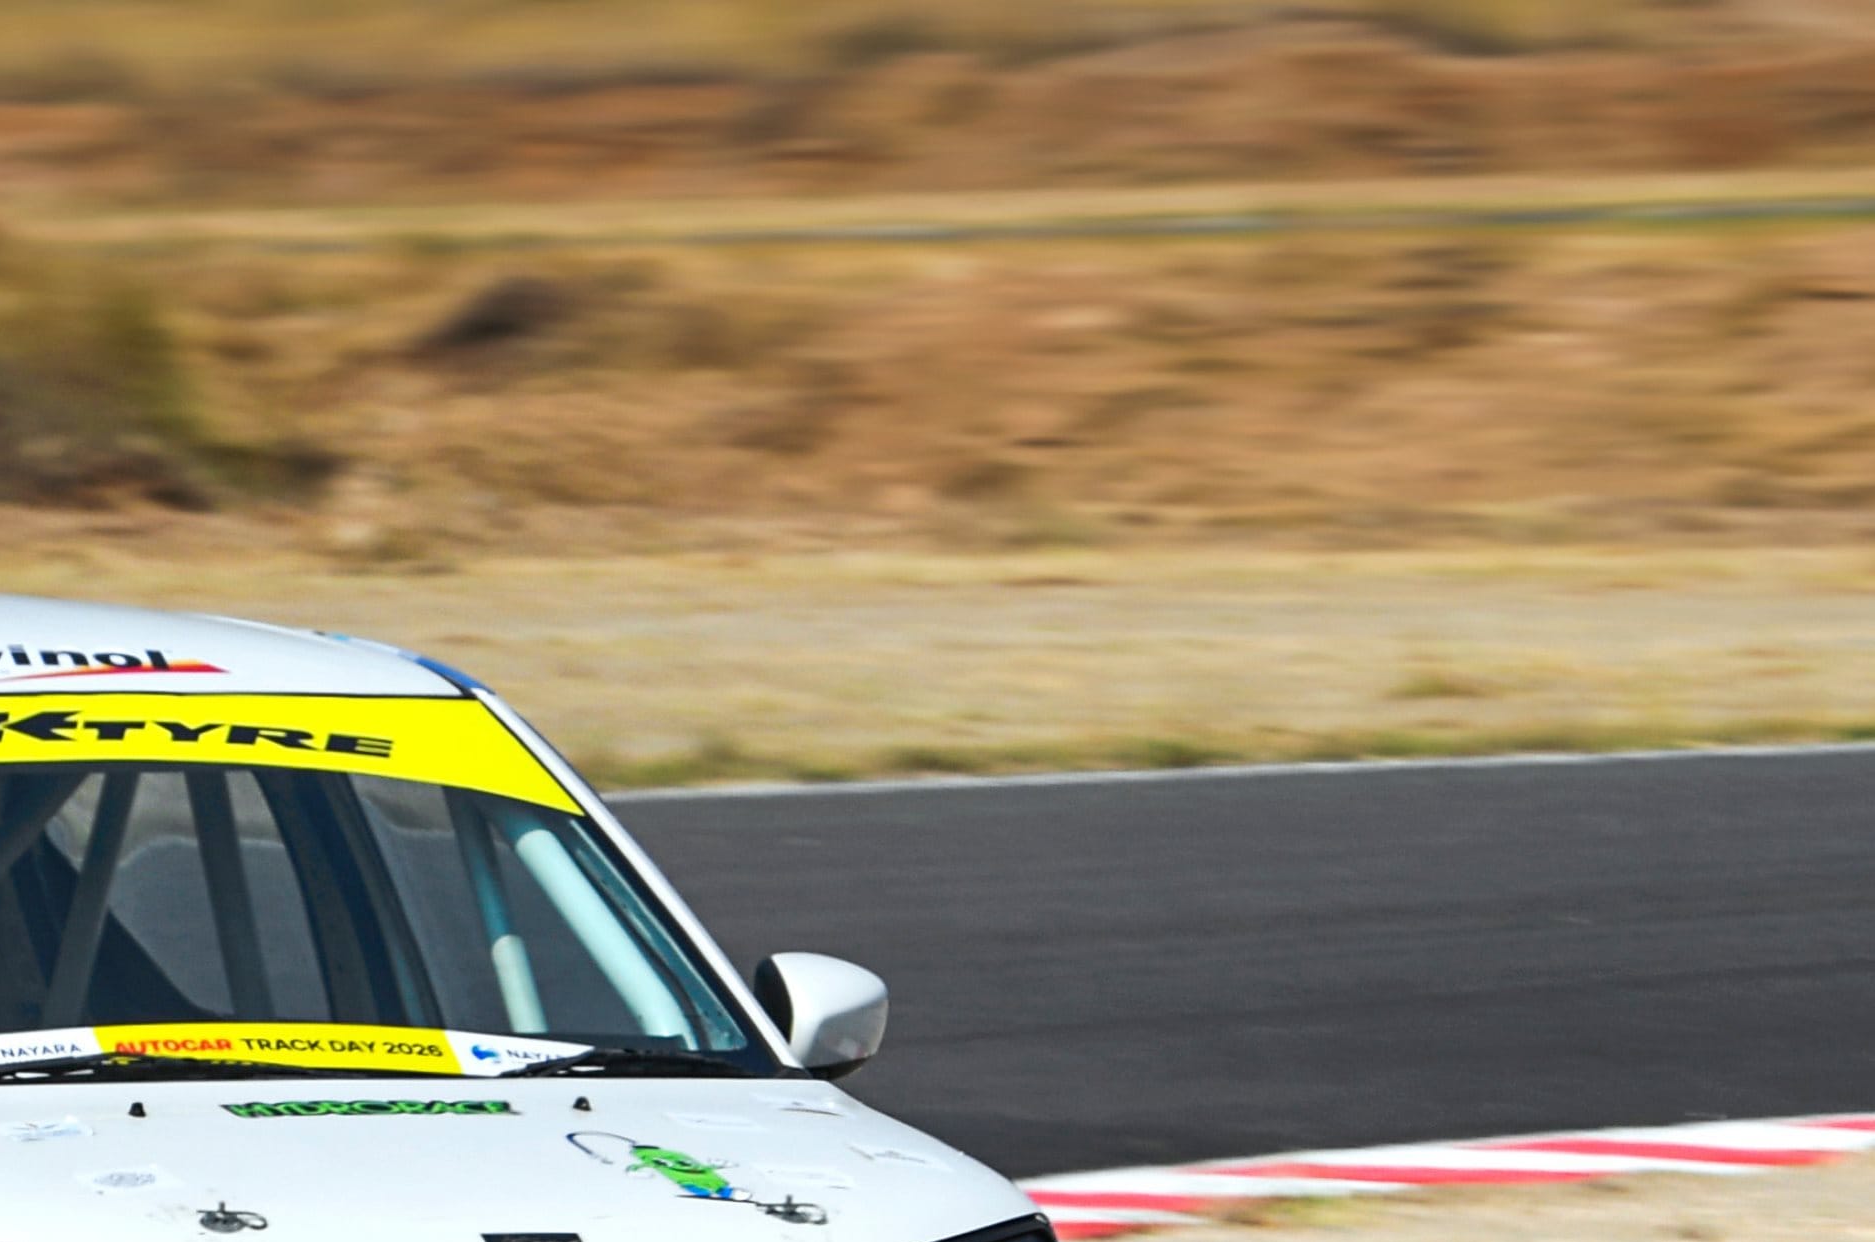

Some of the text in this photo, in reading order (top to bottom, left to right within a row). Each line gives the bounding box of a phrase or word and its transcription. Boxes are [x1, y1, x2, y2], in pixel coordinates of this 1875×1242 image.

[0, 1043, 82, 1058] NAYARA
[115, 1038, 444, 1058] AUTOCAR TRACK DAY 2026
